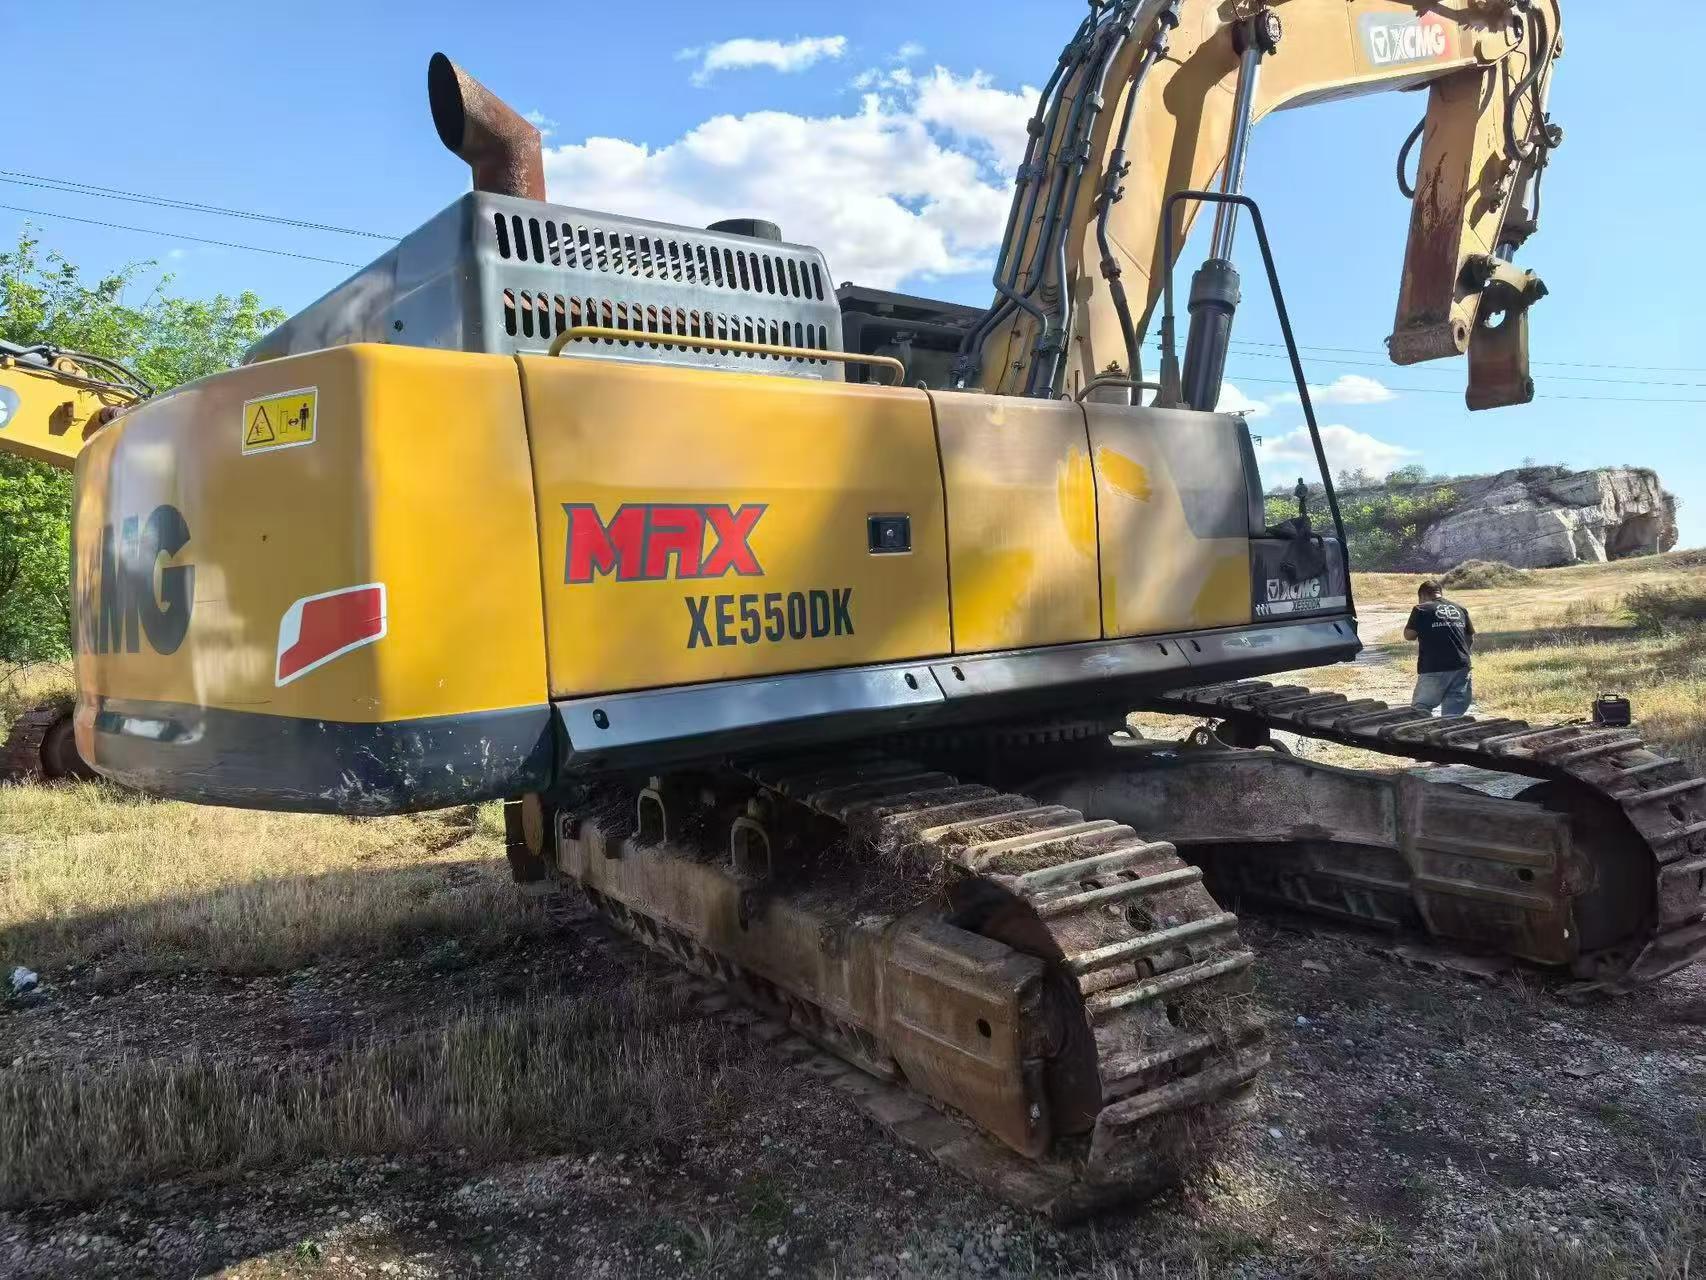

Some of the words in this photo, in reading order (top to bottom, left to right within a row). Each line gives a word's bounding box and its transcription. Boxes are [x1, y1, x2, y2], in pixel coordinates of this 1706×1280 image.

[1390, 24, 1446, 61] XCMG
[561, 502, 769, 584] MAX
[77, 504, 196, 656] MG
[684, 587, 855, 649] XE550DK
